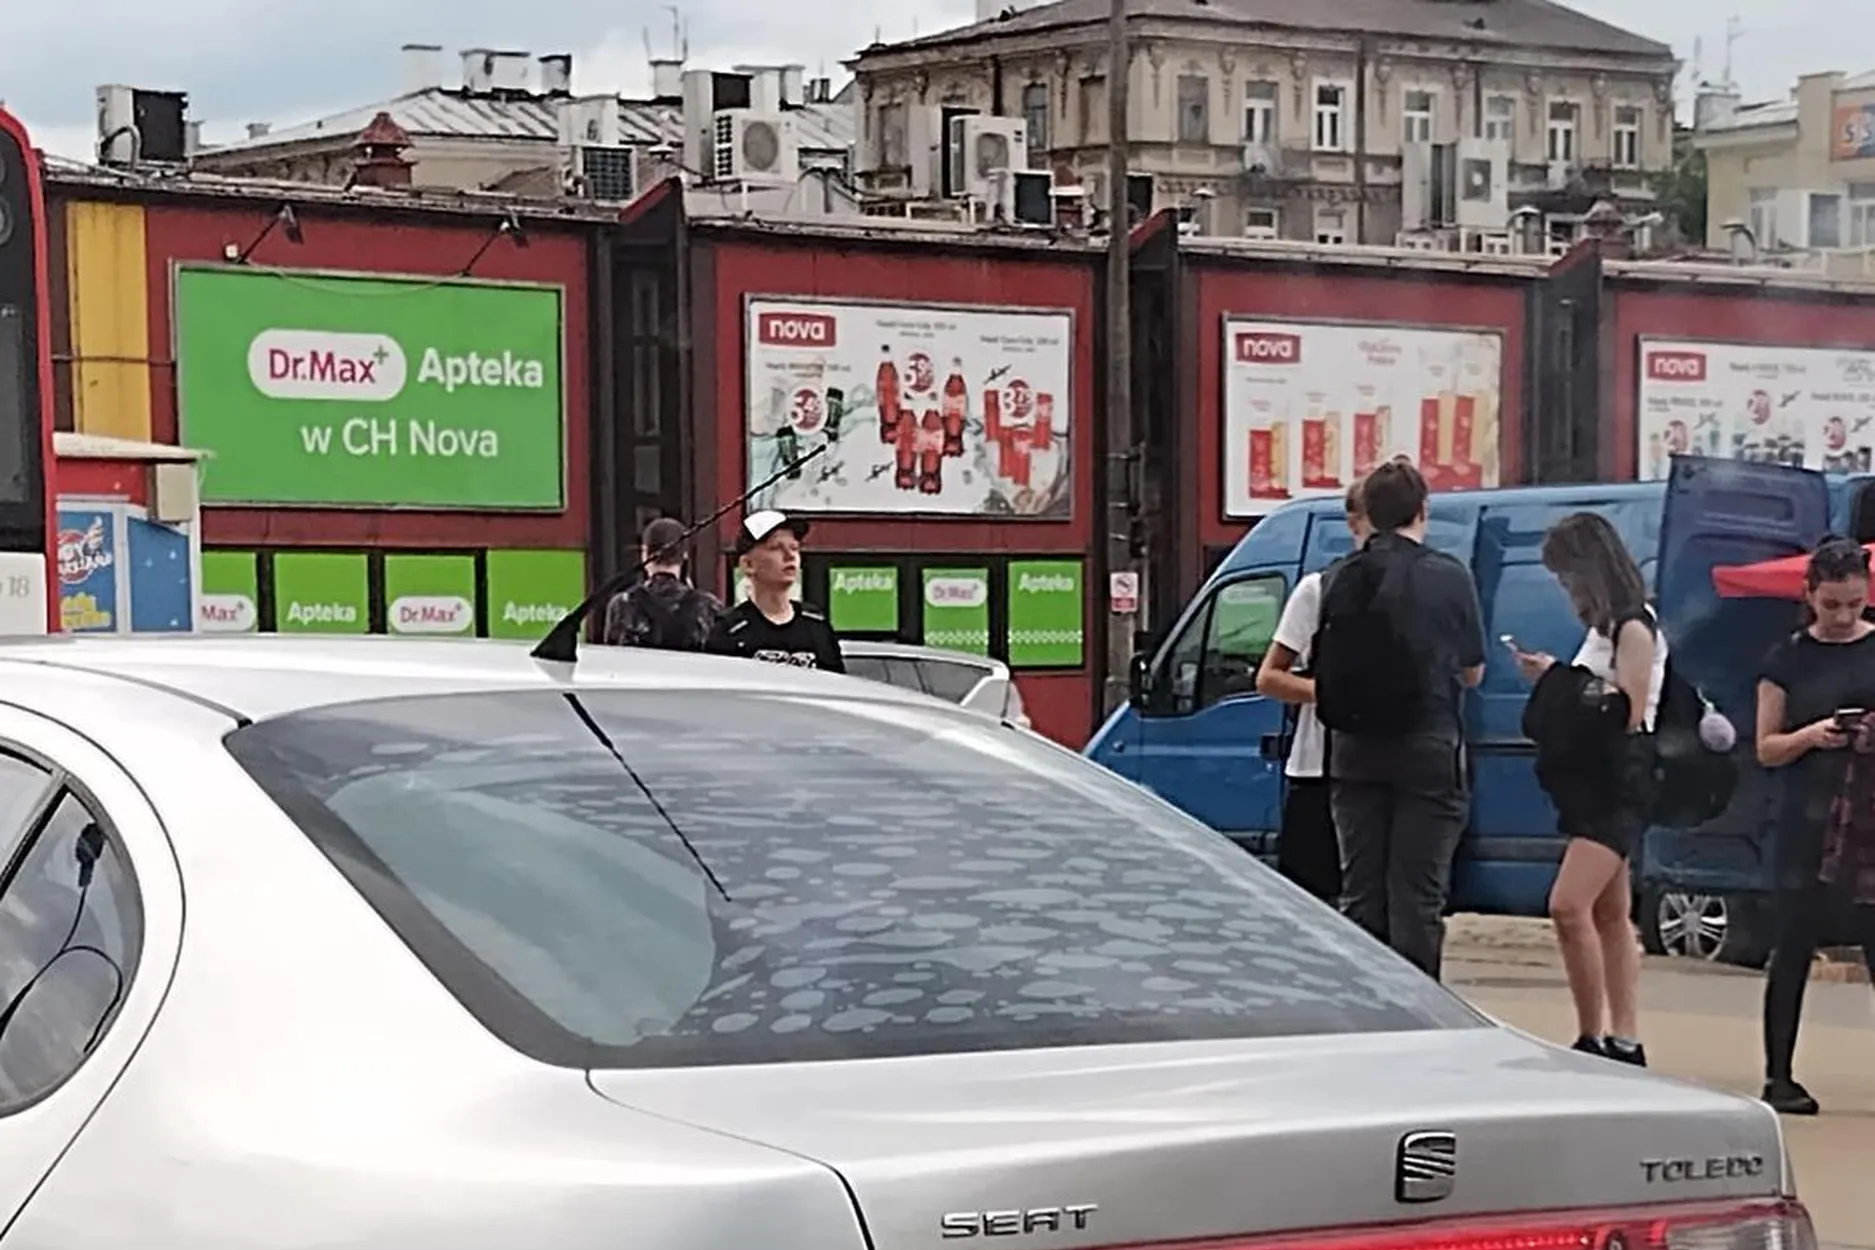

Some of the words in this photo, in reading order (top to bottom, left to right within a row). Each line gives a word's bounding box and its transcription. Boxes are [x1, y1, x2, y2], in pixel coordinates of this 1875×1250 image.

[769, 319, 826, 340] nova
[1242, 338, 1293, 359] nova
[417, 347, 544, 393] Apteka
[1654, 357, 1700, 376] nova
[300, 424, 333, 455] w
[342, 417, 397, 456] CH
[409, 418, 498, 458] Nova
[833, 571, 894, 595] Apteka
[1018, 573, 1076, 595] Apteka
[286, 601, 357, 626] Apteka
[503, 601, 570, 626] Apteka
[1638, 1155, 1764, 1184] TOLEDO
[941, 1203, 1098, 1239] SEAT
